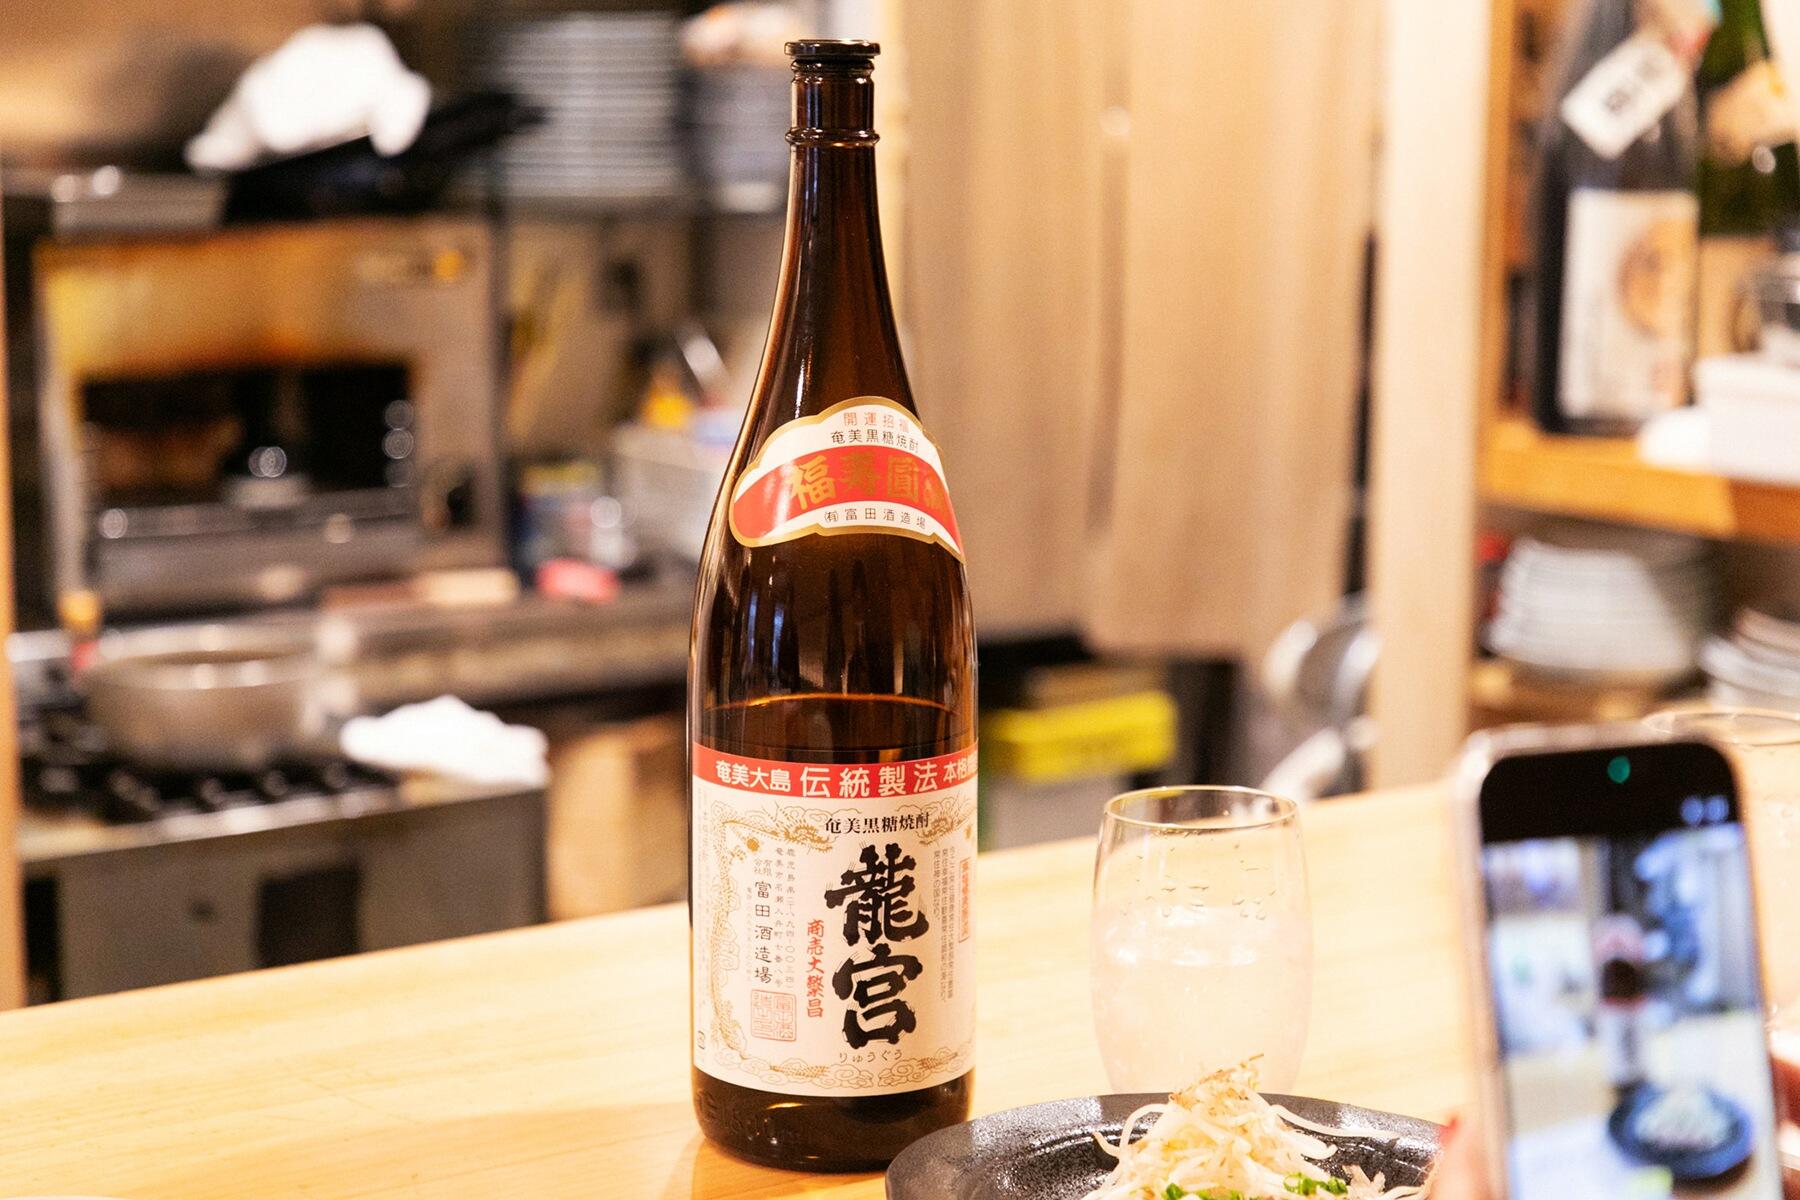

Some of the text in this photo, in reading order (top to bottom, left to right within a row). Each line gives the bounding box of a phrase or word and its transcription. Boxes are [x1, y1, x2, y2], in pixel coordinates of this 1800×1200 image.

[843, 411, 910, 432] 開運招福
[830, 428, 919, 454] 奄美黒糖焼酎
[715, 759, 791, 793] 奄美大島
[799, 762, 938, 799] 伝統製法
[825, 811, 930, 835] 奄美黒糖焼酎
[754, 881, 773, 984] 富田酒造場
[823, 843, 929, 1050] 龍宮
[839, 1048, 903, 1064] りゅうぐう
